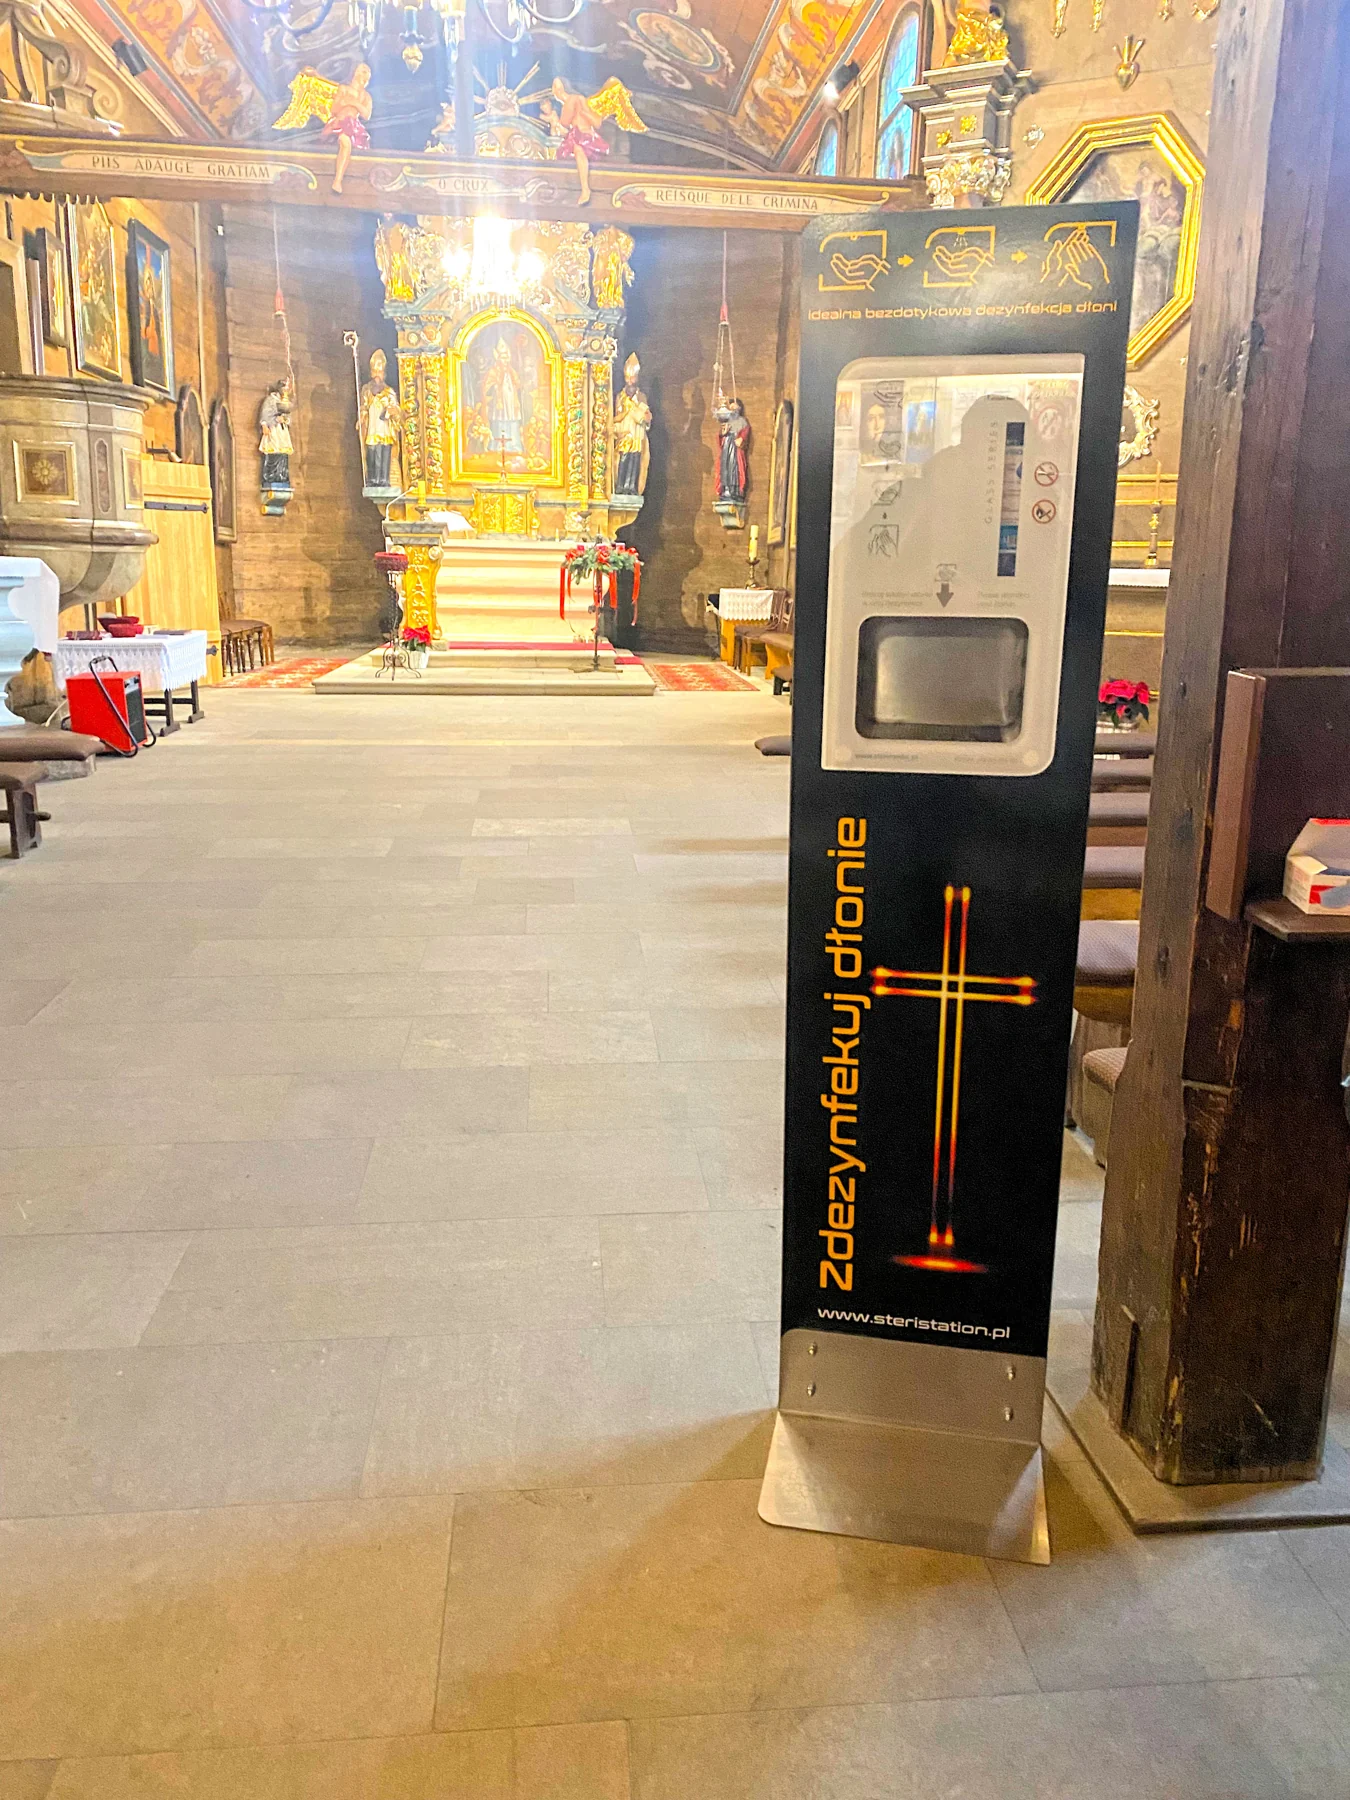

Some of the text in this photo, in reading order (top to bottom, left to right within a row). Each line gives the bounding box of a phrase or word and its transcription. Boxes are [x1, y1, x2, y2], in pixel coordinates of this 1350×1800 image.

[91, 155, 270, 178] PIIS ADAUGE GRATIAM
[453, 178, 489, 193] CRUX
[721, 192, 753, 206] DELE
[763, 195, 819, 210] CRIMINA
[865, 306, 972, 320] bezdotykowa
[975, 301, 1073, 318] dezynfekcja
[819, 817, 871, 1291] Zdezynfekuj dłonie
[818, 1308, 1010, 1339] www.steristation.pl
